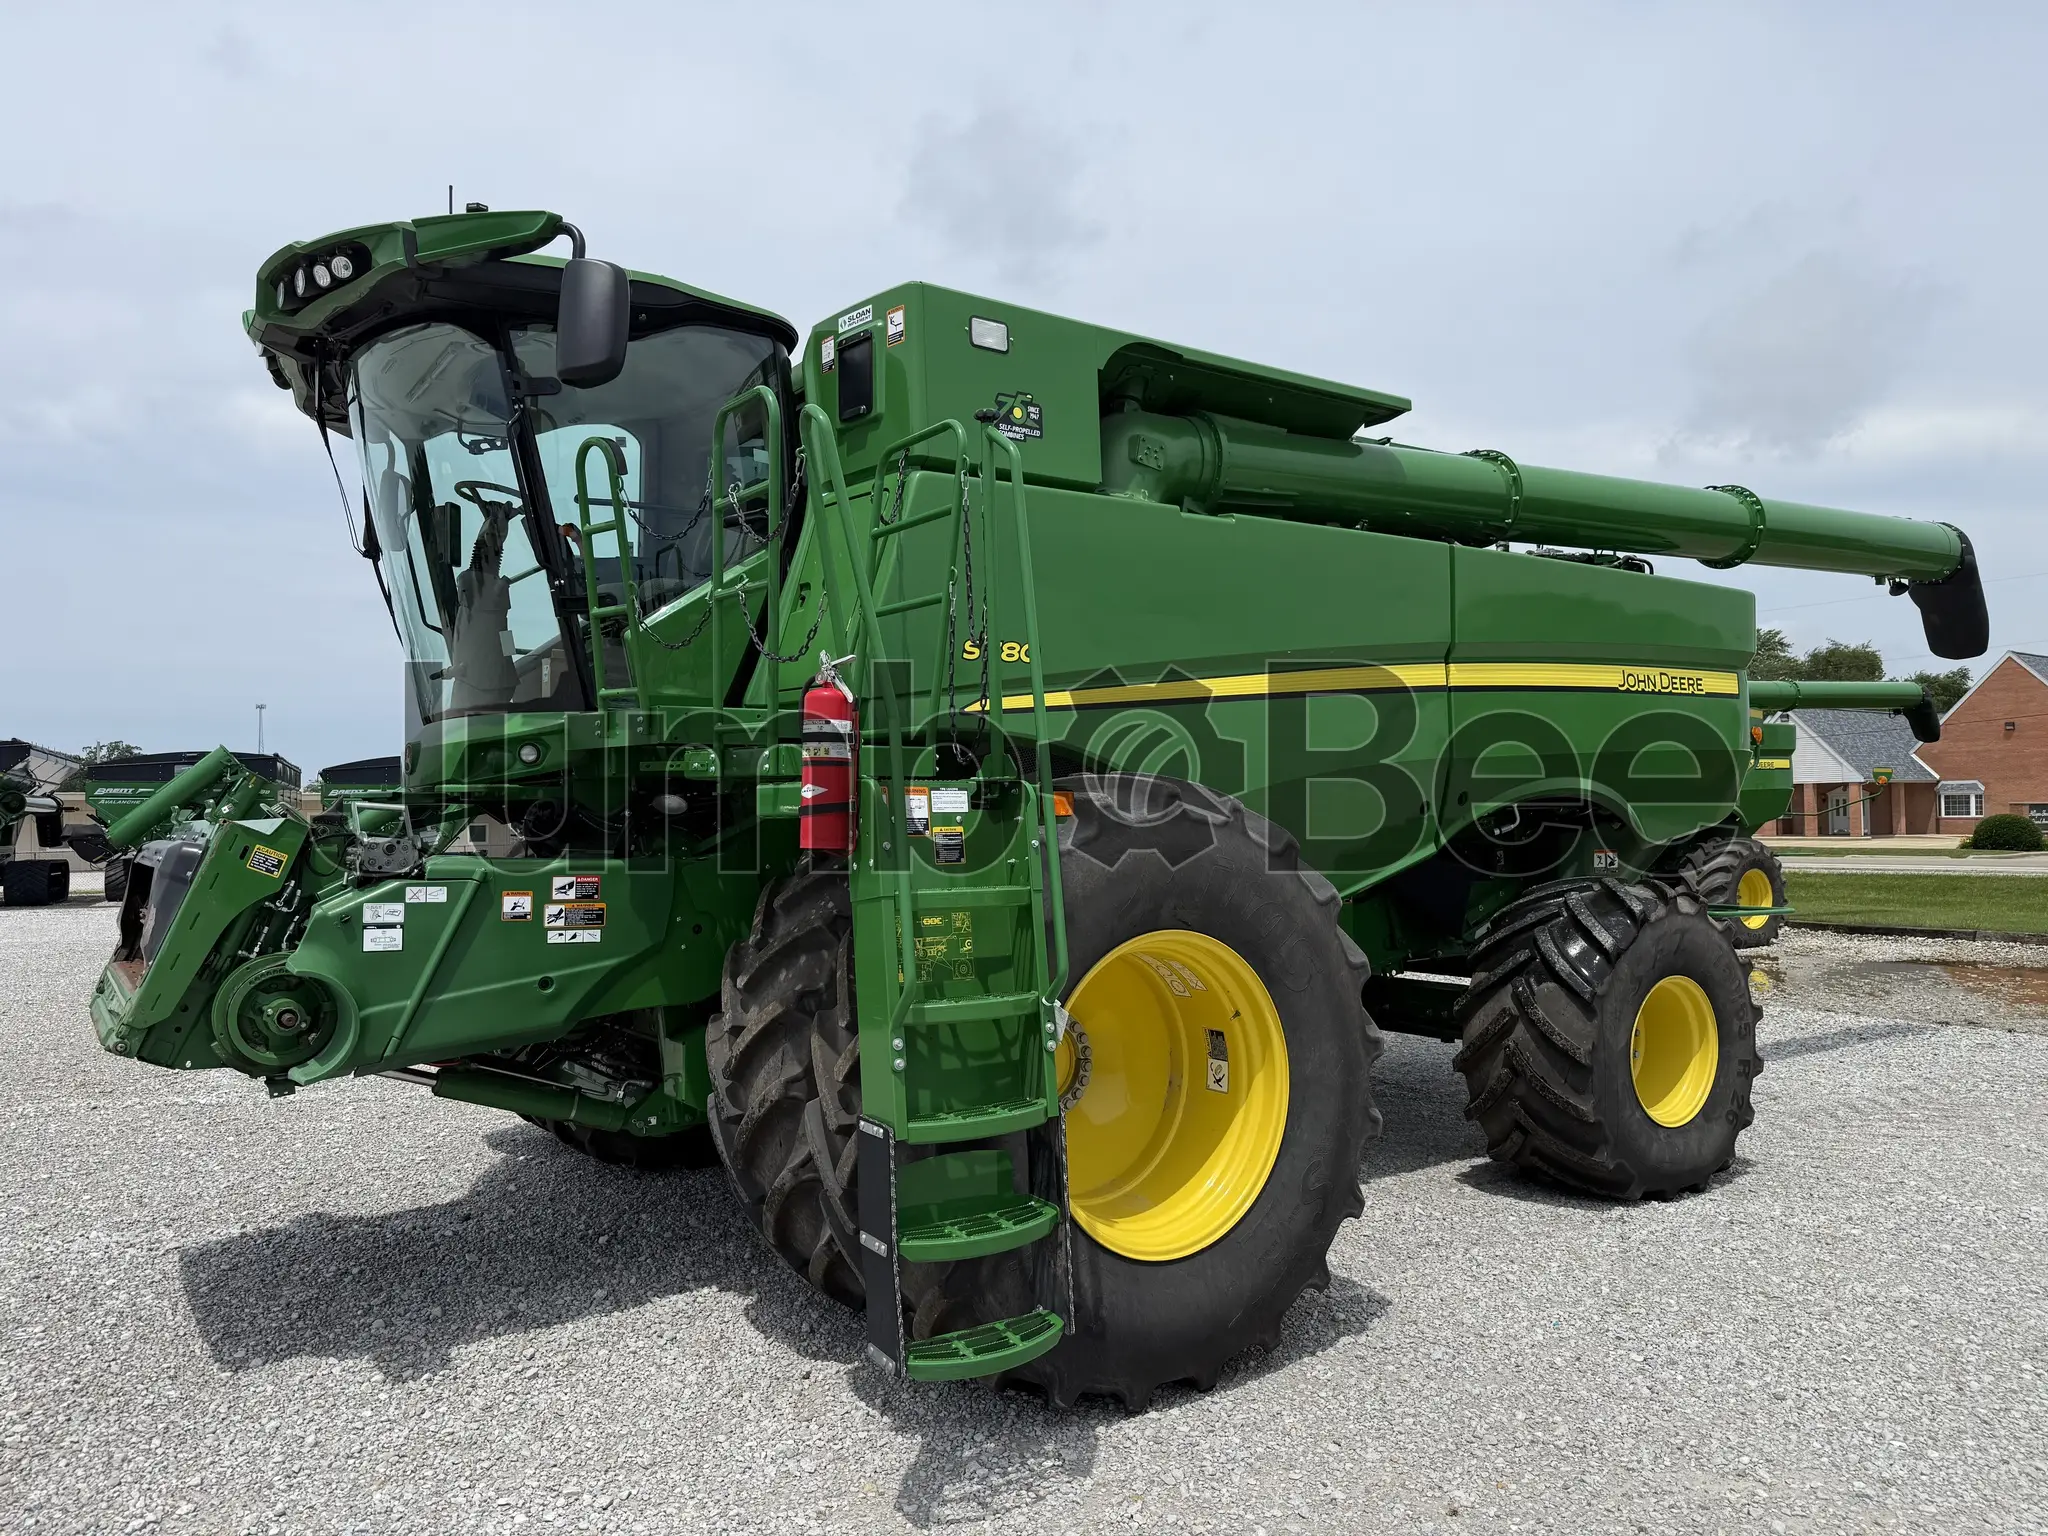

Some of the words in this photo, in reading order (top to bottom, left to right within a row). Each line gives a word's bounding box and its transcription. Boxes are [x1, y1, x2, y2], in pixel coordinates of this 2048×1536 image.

[847, 308, 871, 323] SLOAN
[847, 314, 871, 328] IMPLEMENT
[1029, 412, 1040, 420] 1947
[999, 423, 1041, 437] SELF-PROPELLED
[962, 639, 1031, 664] S80
[1618, 669, 1658, 691] JOHN
[1659, 672, 1705, 694] DEERE
[94, 787, 136, 795] BRENT
[261, 847, 287, 860] CAUTION
[1724, 1088, 1746, 1131] 26
